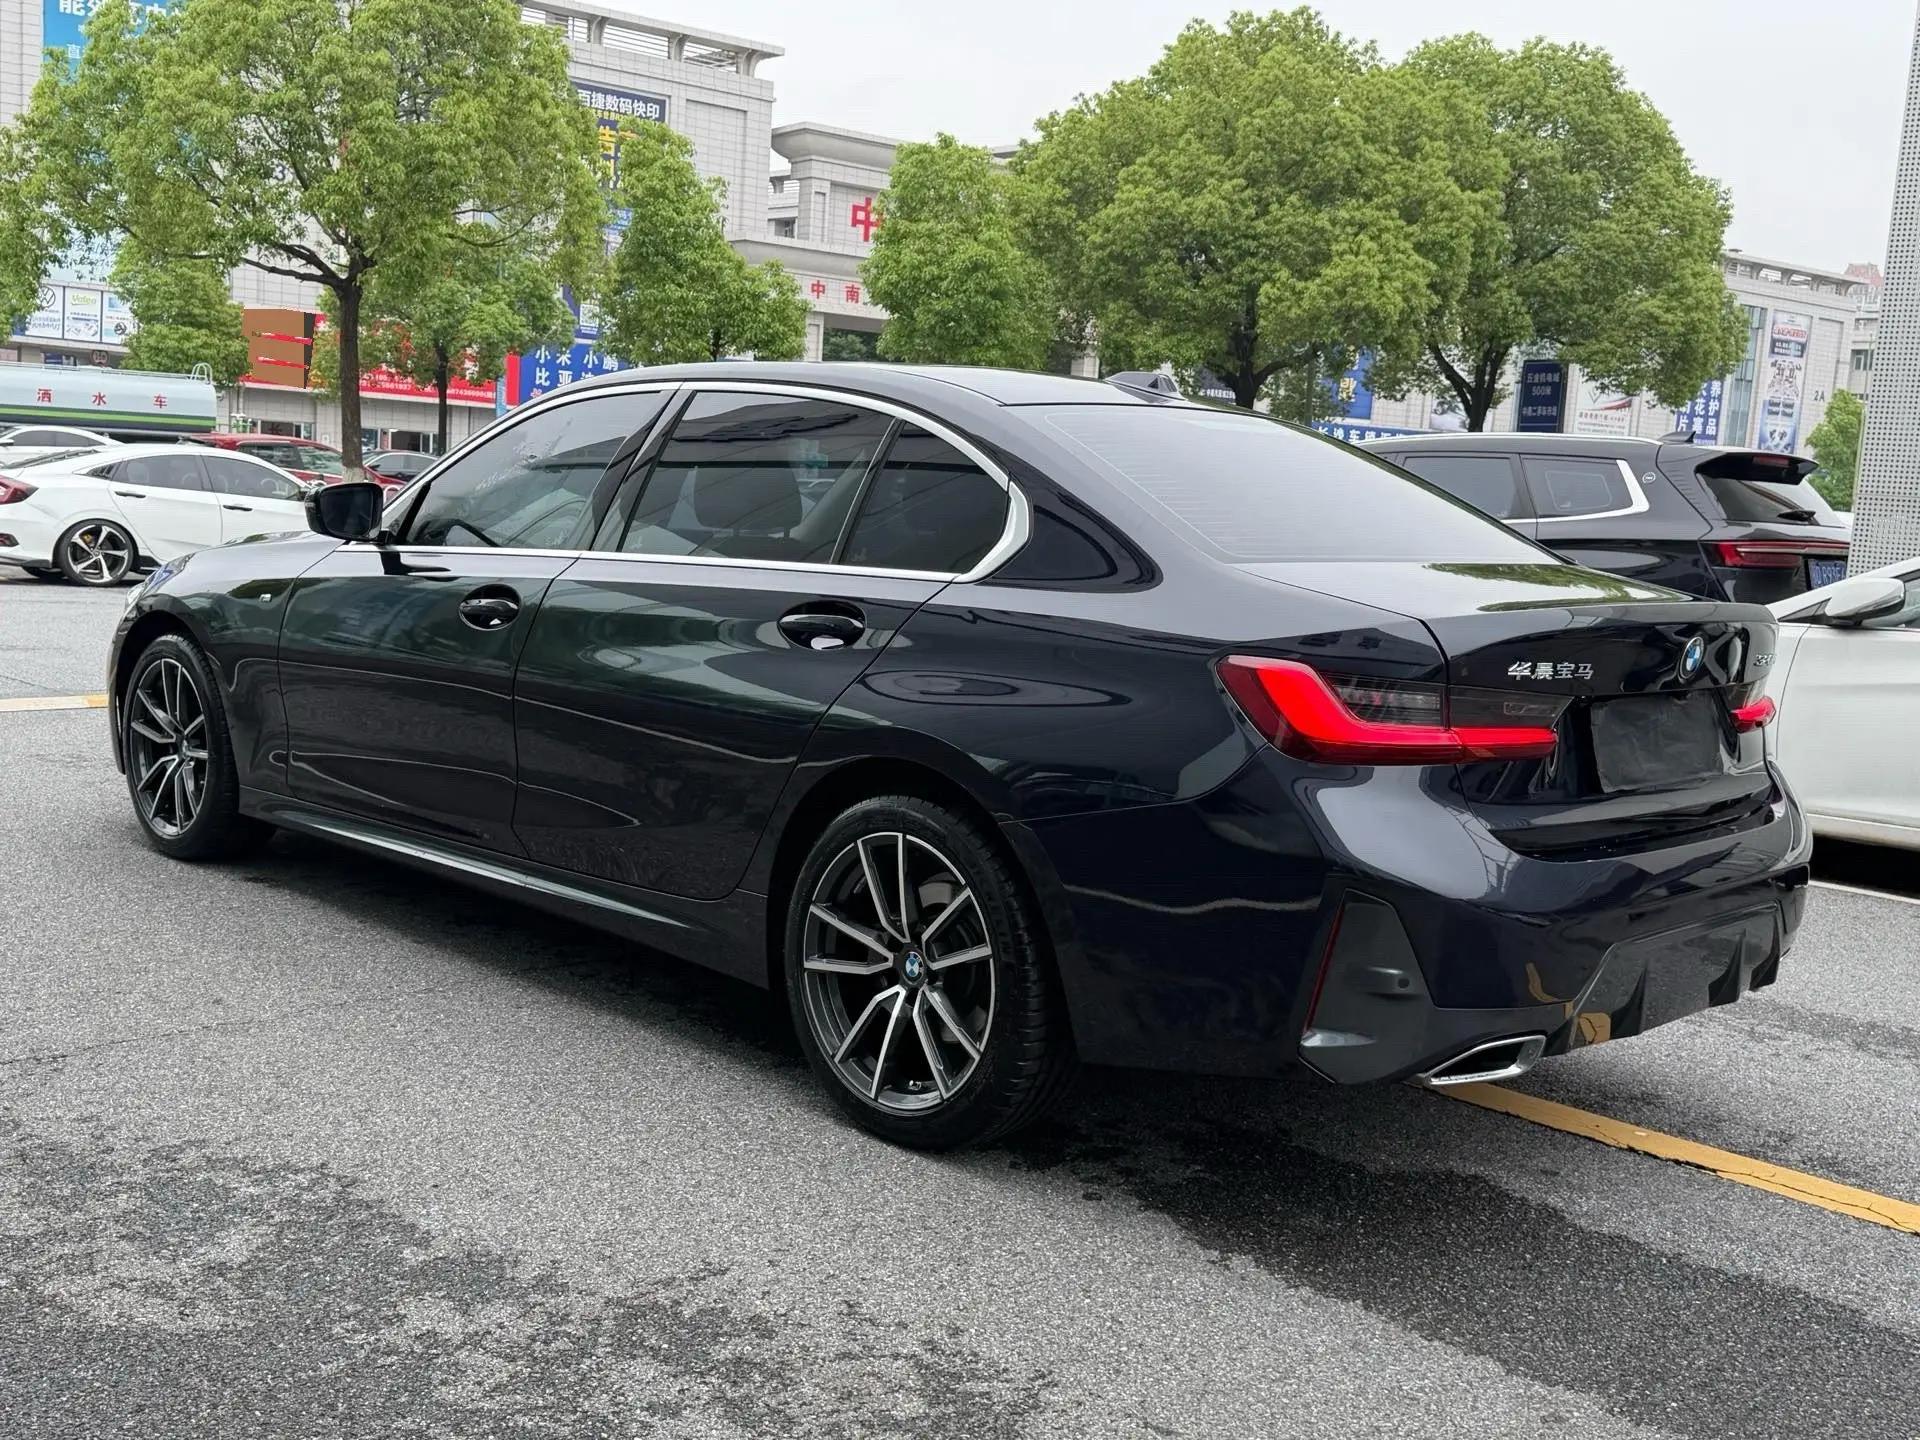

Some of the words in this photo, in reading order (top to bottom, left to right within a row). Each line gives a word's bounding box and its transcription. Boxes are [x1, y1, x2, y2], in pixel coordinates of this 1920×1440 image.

[535, 345, 572, 366] 小米
[583, 349, 619, 371] 小鹏
[37, 388, 168, 409] 洒水车
[1814, 390, 1825, 402] 2A
[1507, 661, 1594, 681] 华晨宝马
